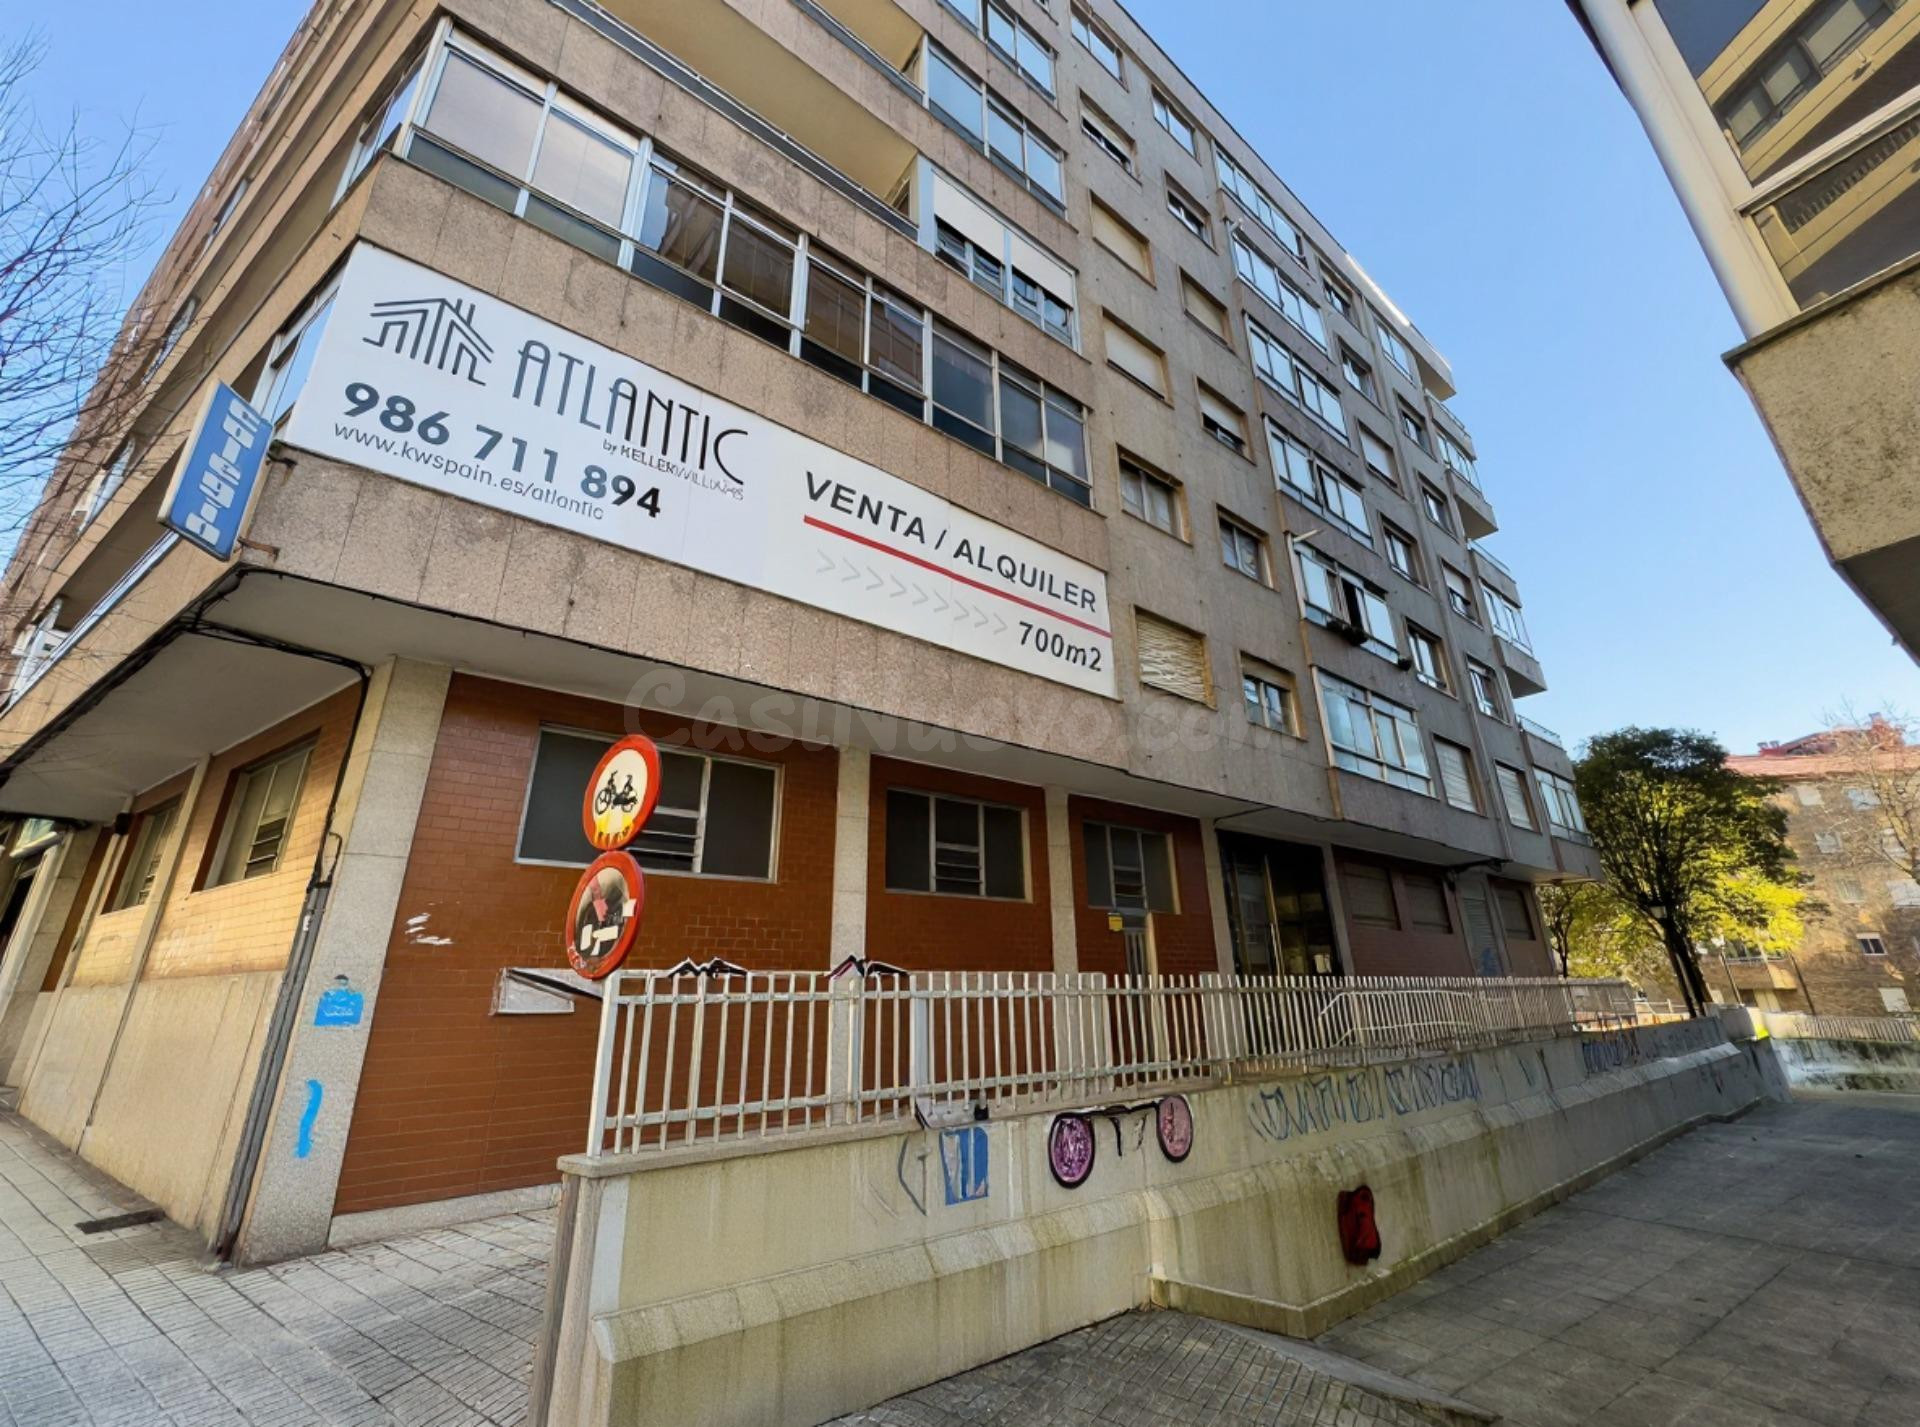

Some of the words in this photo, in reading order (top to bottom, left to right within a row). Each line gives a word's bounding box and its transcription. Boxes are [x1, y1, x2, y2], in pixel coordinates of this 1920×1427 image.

[344, 381, 451, 446] 986
[474, 424, 557, 483] 711
[581, 464, 662, 519] 894
[513, 339, 749, 485] ATLANTIC
[602, 439, 618, 456] by
[333, 422, 604, 521] www.kwspain.es/atlantic
[805, 471, 926, 544] VENTA
[953, 538, 1097, 613] ALQUILER
[1018, 621, 1102, 672] 700m2
